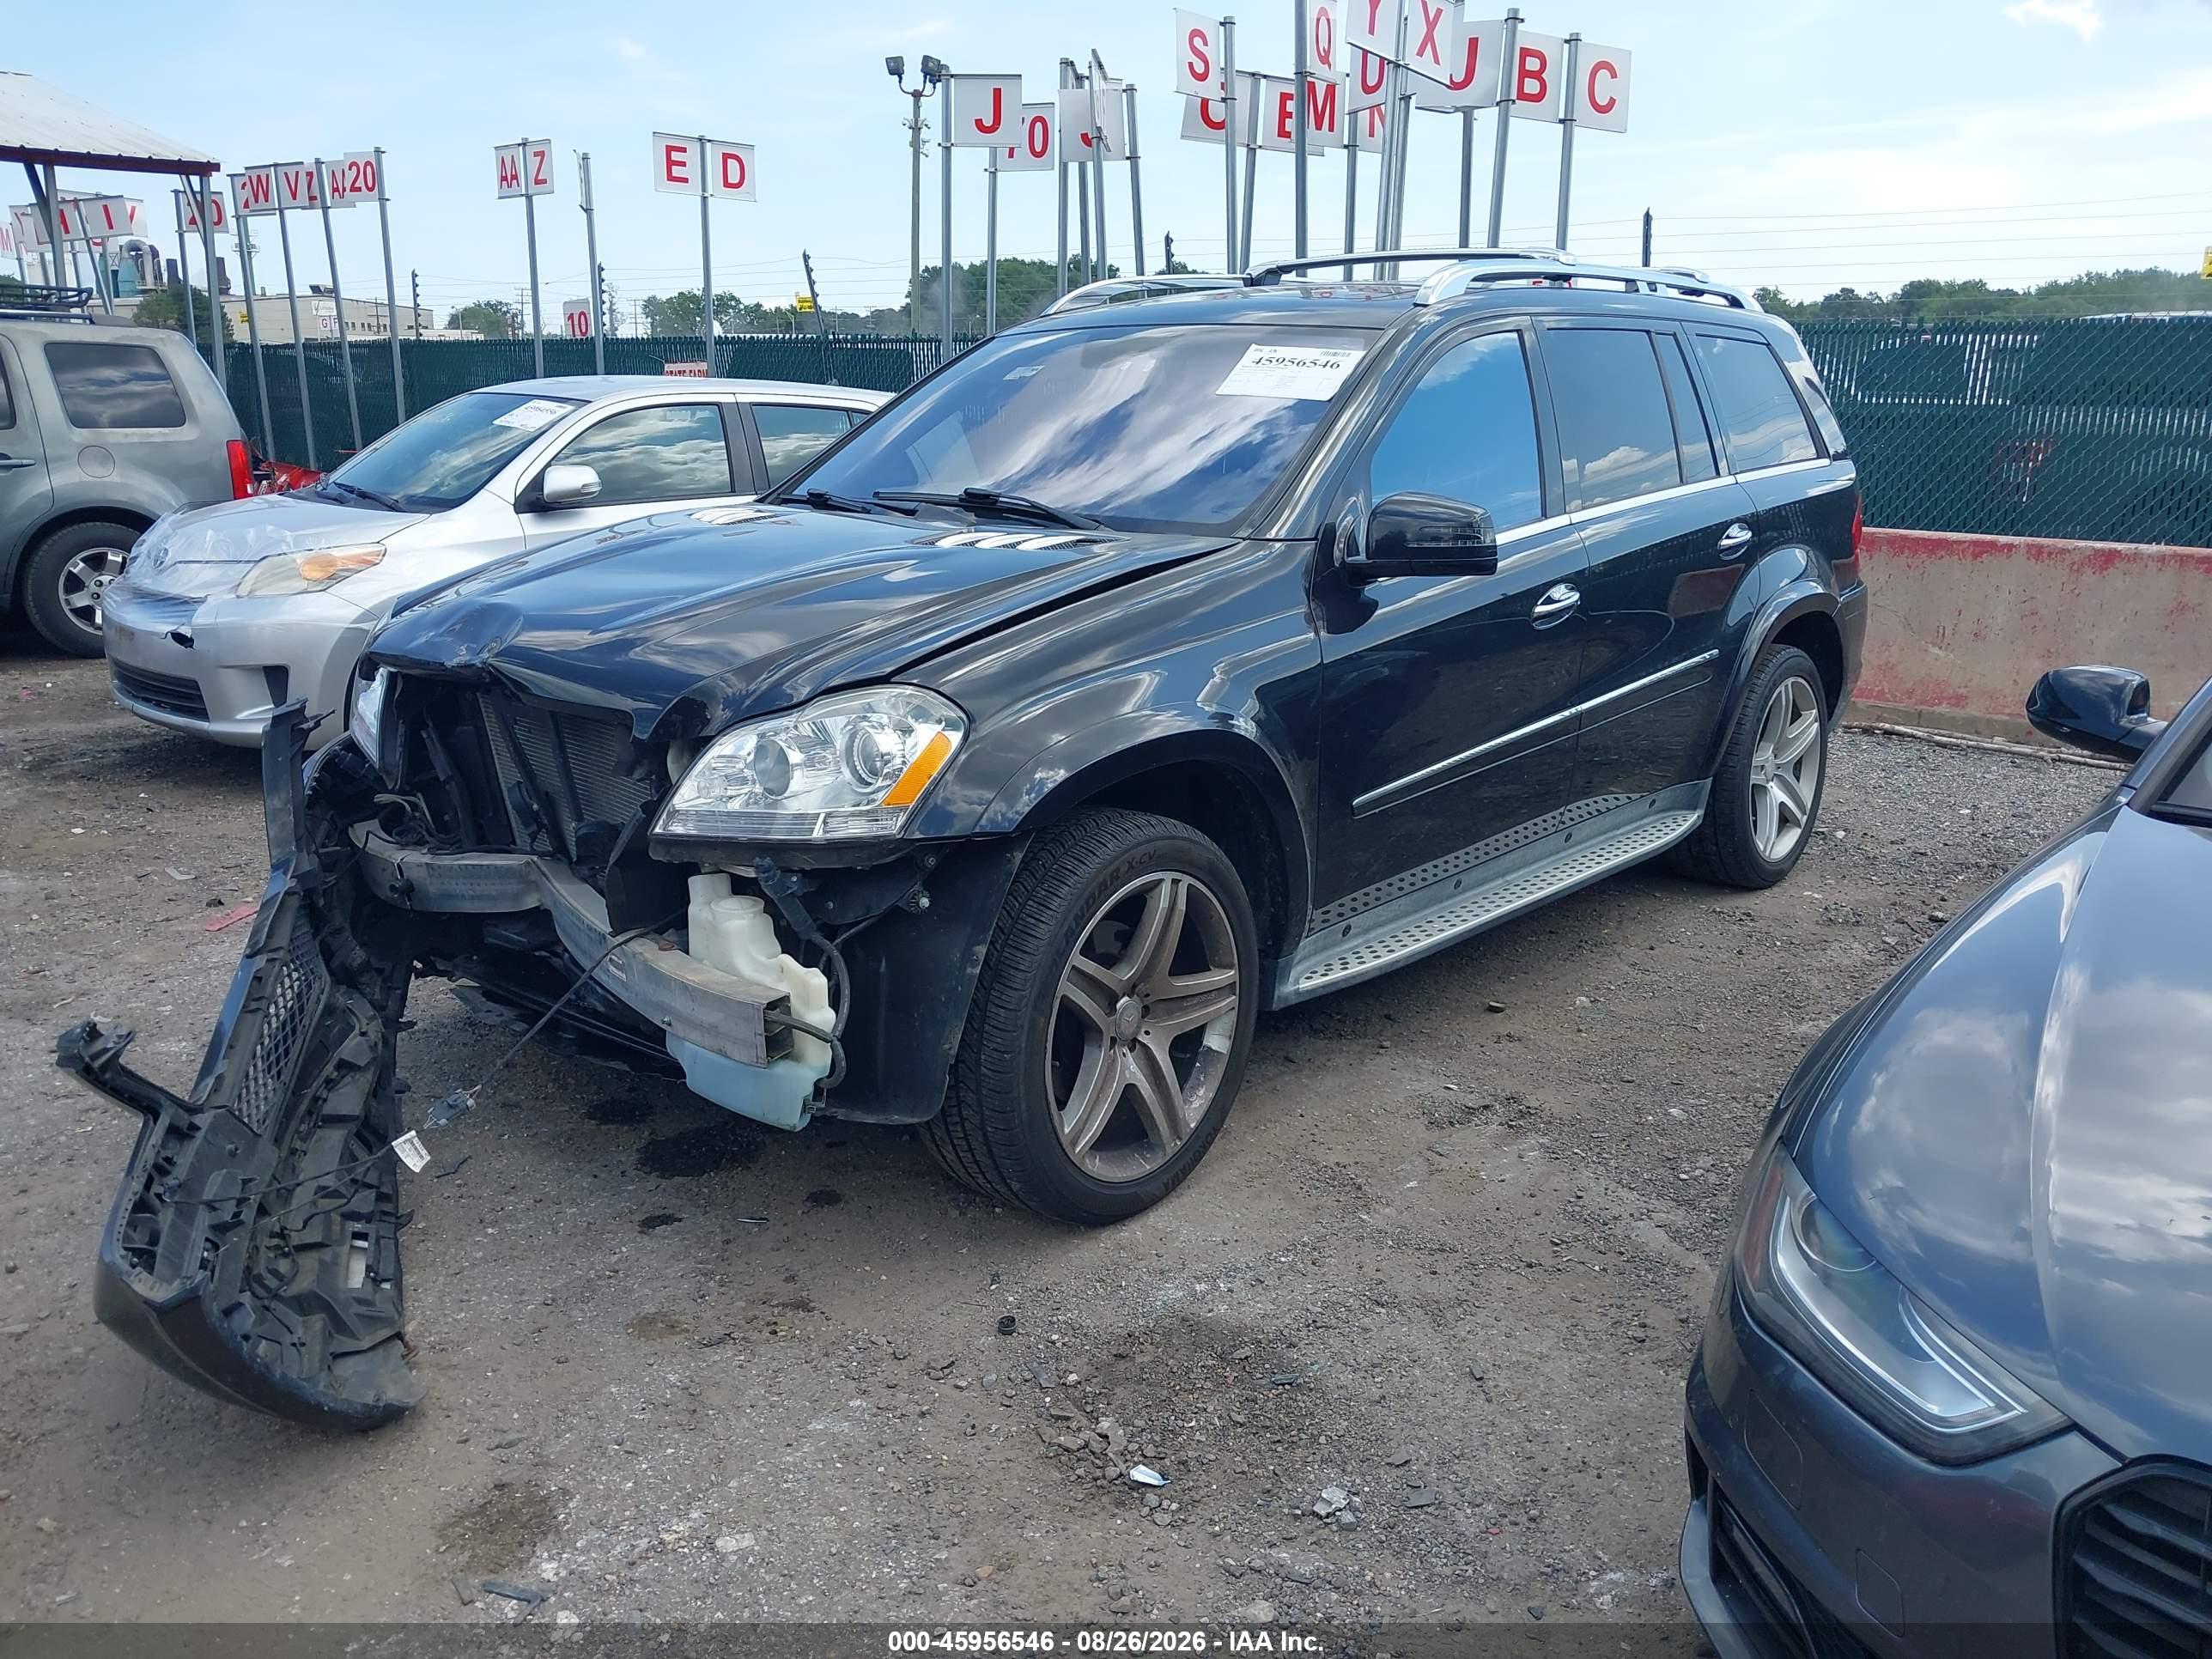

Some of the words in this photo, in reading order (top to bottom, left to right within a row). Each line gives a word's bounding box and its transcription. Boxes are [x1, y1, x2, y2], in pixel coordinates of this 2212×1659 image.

[1187, 27, 1211, 83] S
[1316, 7, 1332, 71] Q
[1416, 0, 1443, 65] X
[1449, 36, 1480, 91] J
[1516, 46, 1548, 103] B
[1587, 60, 1618, 115] C
[974, 87, 1003, 135] J
[1276, 91, 1295, 140] E
[1306, 80, 1337, 133] M
[247, 173, 270, 204] W
[283, 170, 300, 202] V
[348, 160, 376, 193] 20
[500, 155, 520, 189] AA
[533, 150, 548, 186] Z
[665, 143, 690, 185] E
[721, 151, 746, 190] D
[567, 310, 589, 337] 10
[1251, 356, 1342, 370] 45956546
